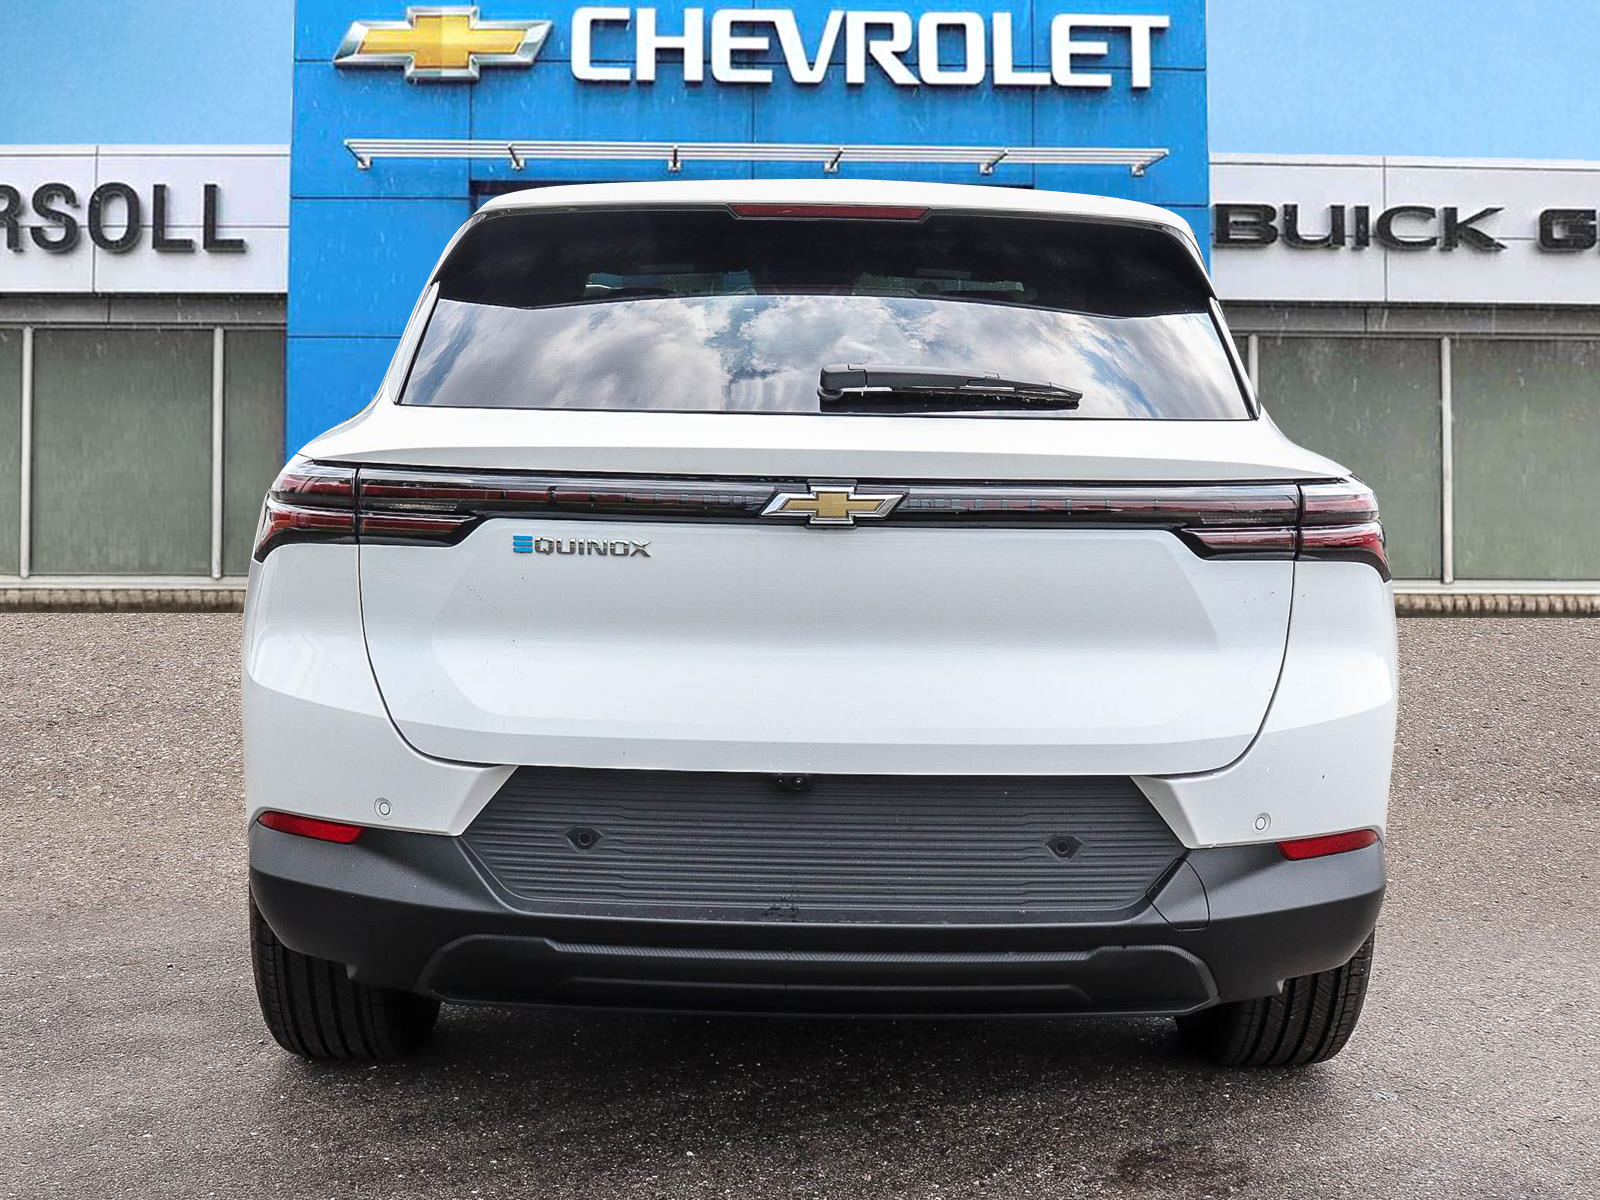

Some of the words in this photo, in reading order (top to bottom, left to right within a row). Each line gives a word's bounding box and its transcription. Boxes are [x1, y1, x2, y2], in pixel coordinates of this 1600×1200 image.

[570, 6, 1170, 89] CHEVROLET
[1213, 203, 1507, 251] BUICK
[513, 535, 651, 557] EQUINOX
